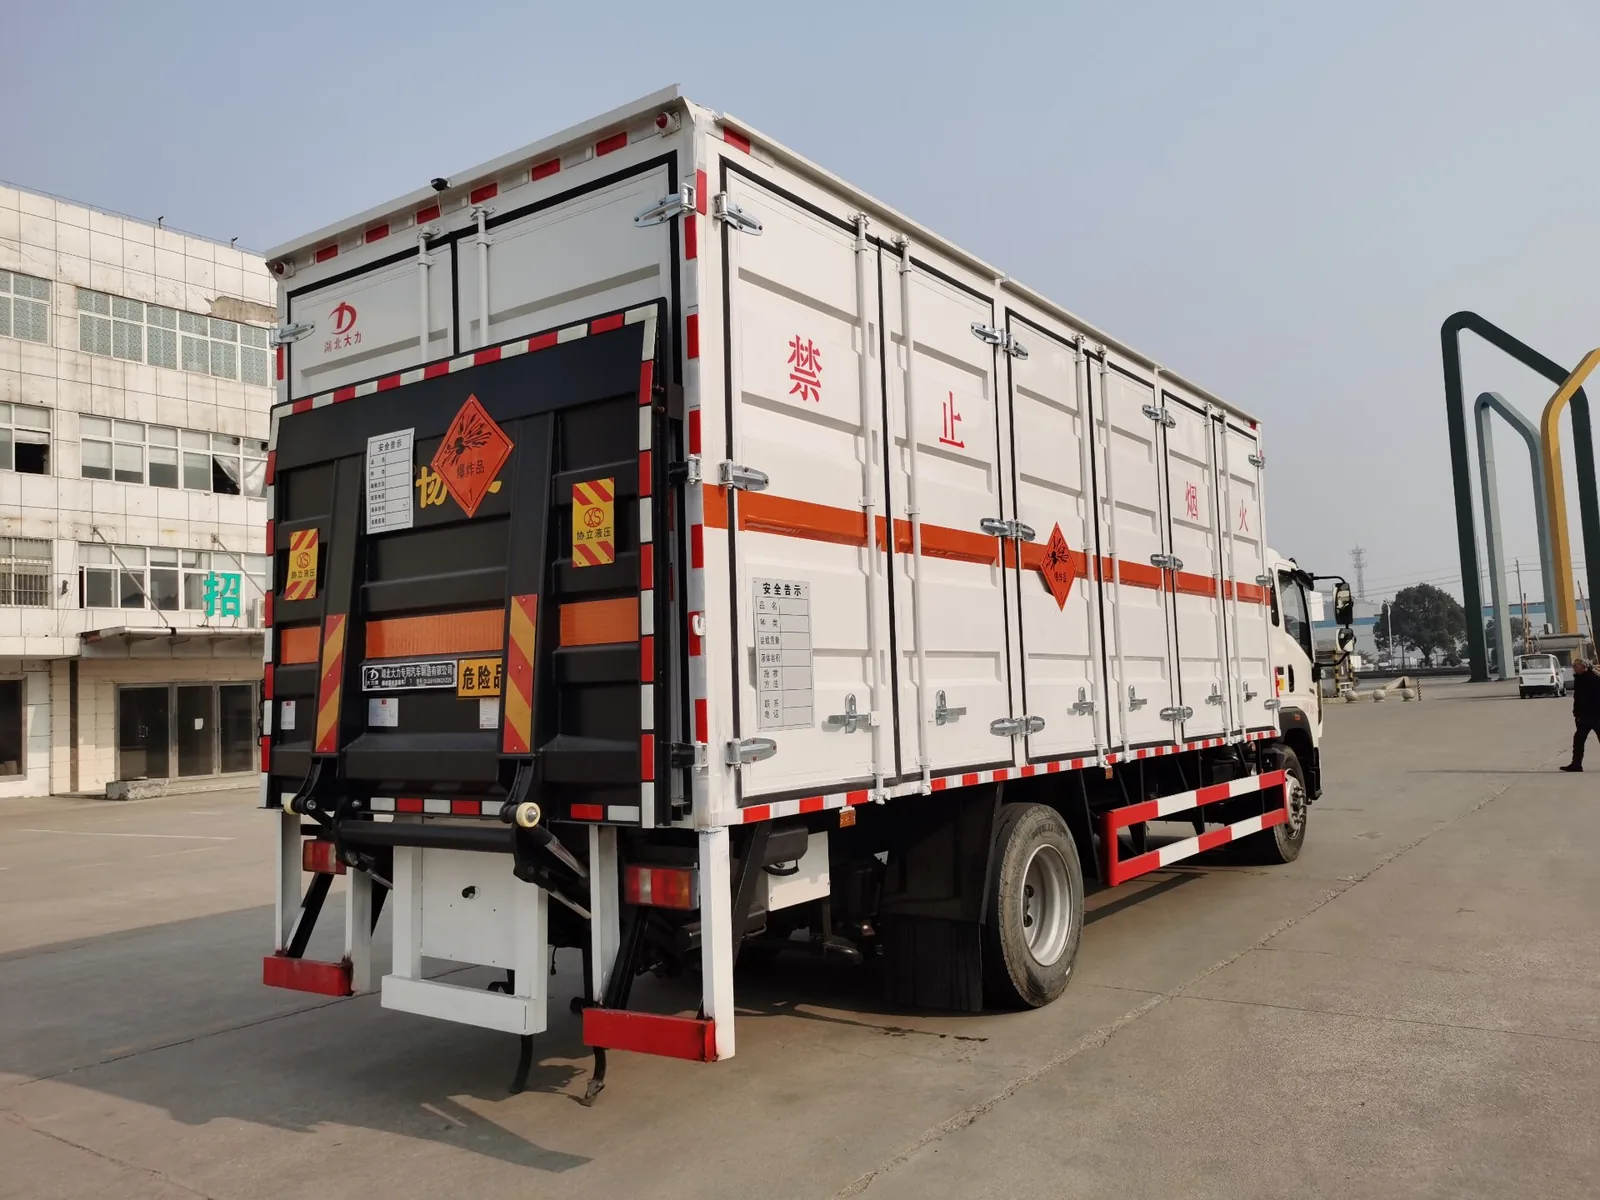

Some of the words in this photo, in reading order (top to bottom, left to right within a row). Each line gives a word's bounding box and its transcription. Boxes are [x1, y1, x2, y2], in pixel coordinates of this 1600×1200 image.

[324, 331, 362, 353] 湖北大力
[787, 335, 822, 402] 禁
[939, 391, 965, 449] 止
[1185, 481, 1199, 520] 烟
[1239, 499, 1249, 532] 火
[456, 459, 484, 479] 爆炸品
[577, 527, 611, 541] 协立液压
[203, 571, 242, 618] 招
[763, 582, 802, 597] 安全告示
[462, 664, 502, 690] 危险品
